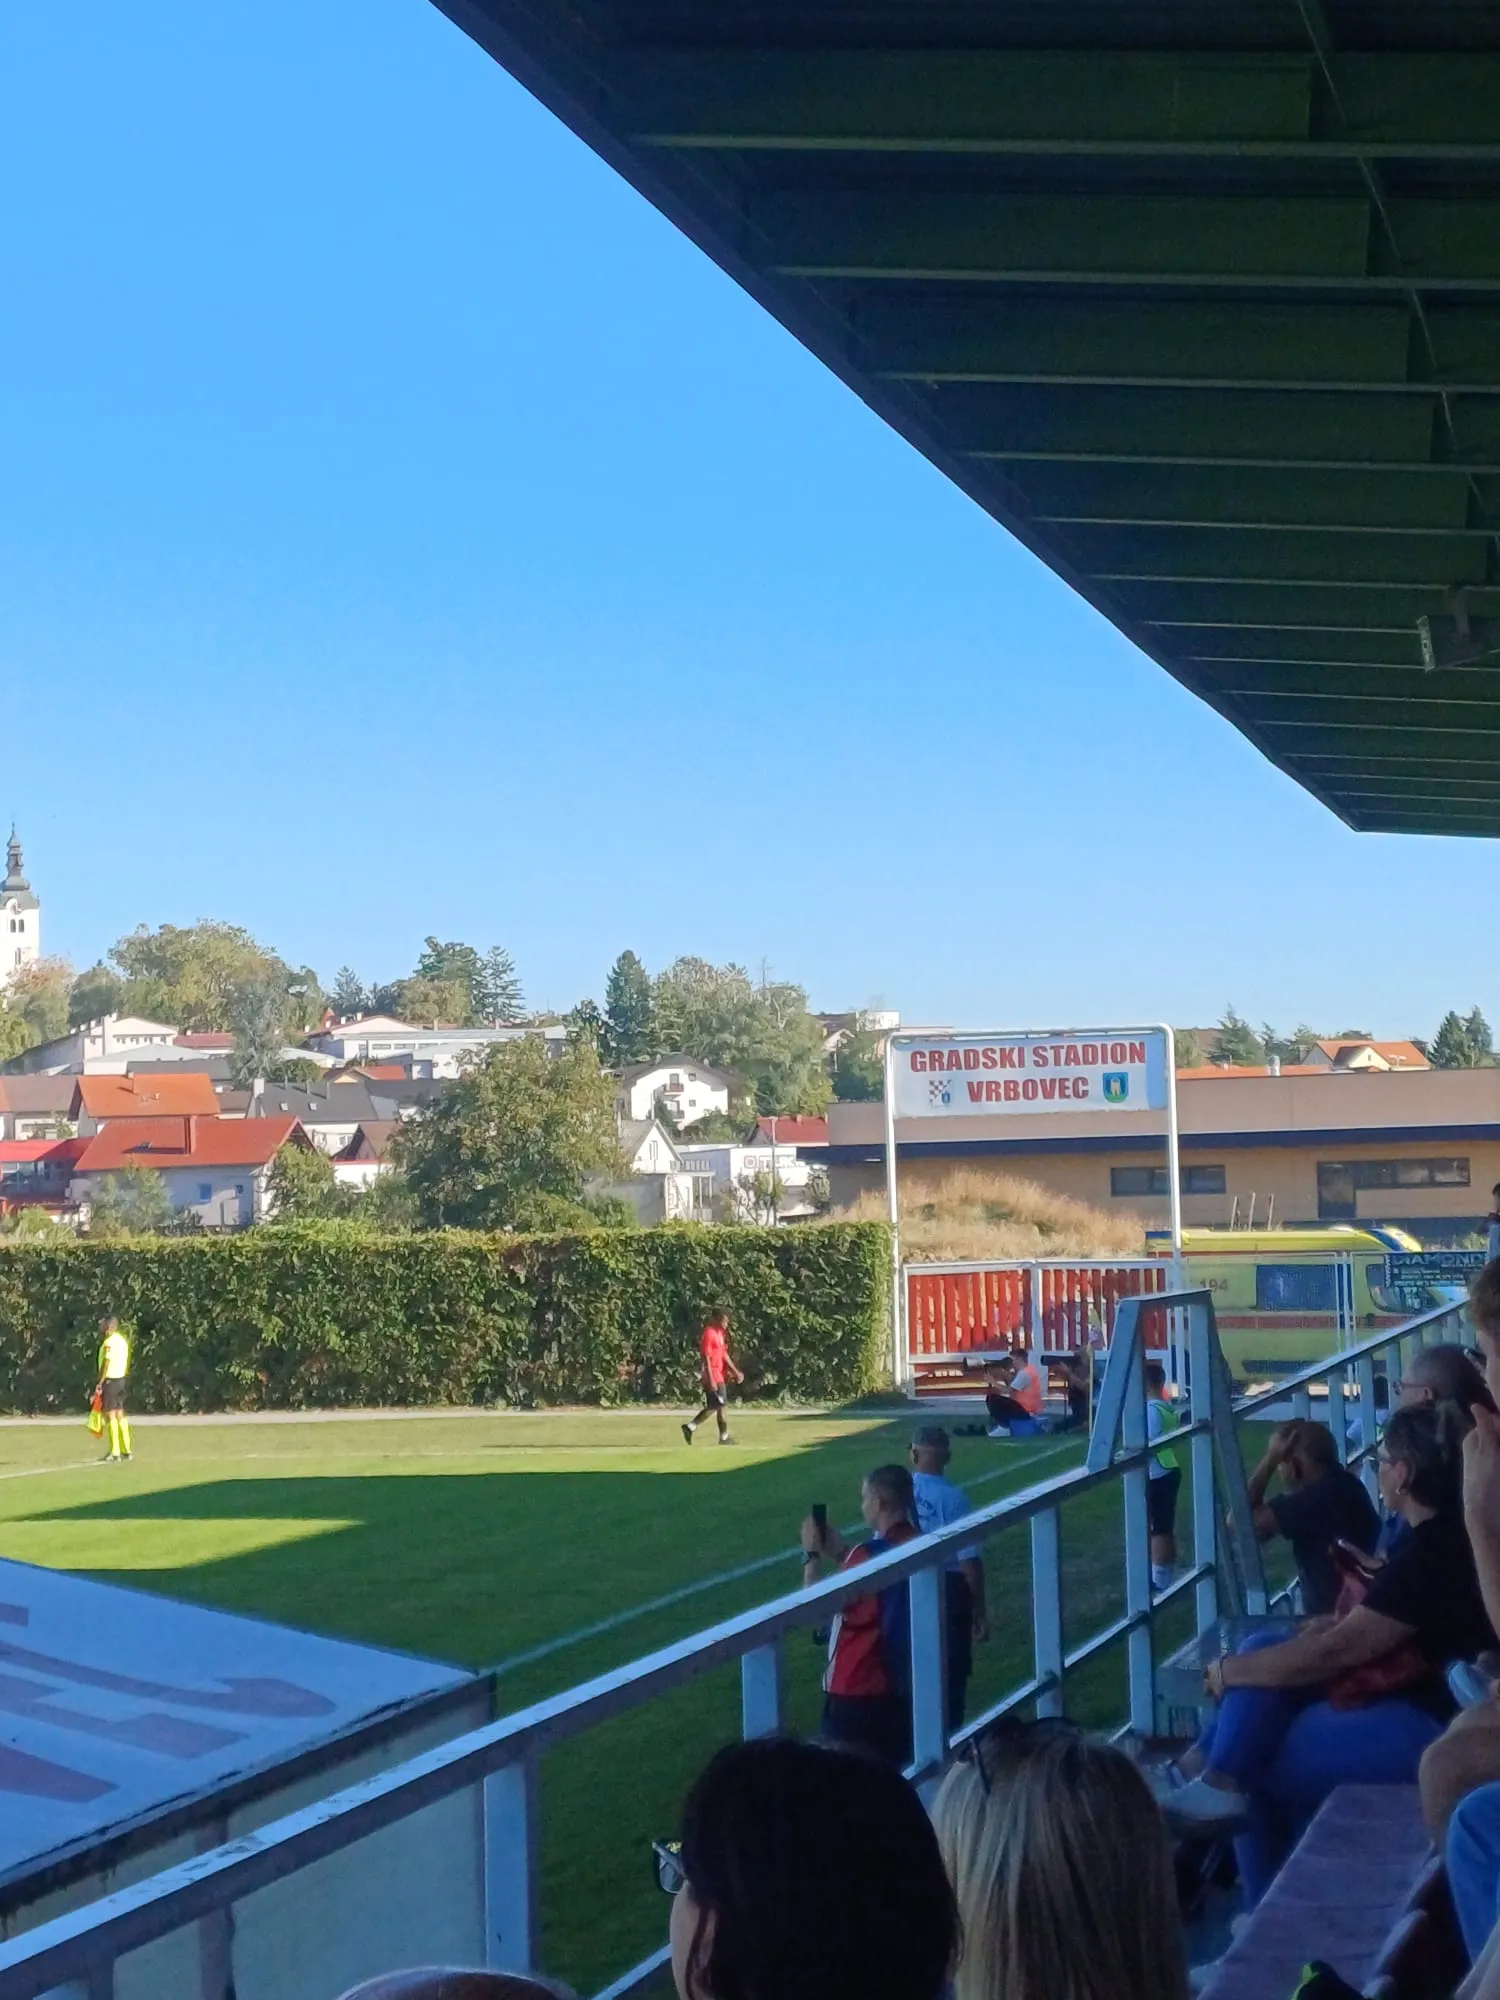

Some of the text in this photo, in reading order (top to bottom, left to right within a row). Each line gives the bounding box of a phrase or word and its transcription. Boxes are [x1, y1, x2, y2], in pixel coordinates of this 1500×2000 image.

[910, 1041, 1146, 1072] GRADSKI STADION
[967, 1077, 1090, 1103] VRBOVEC
